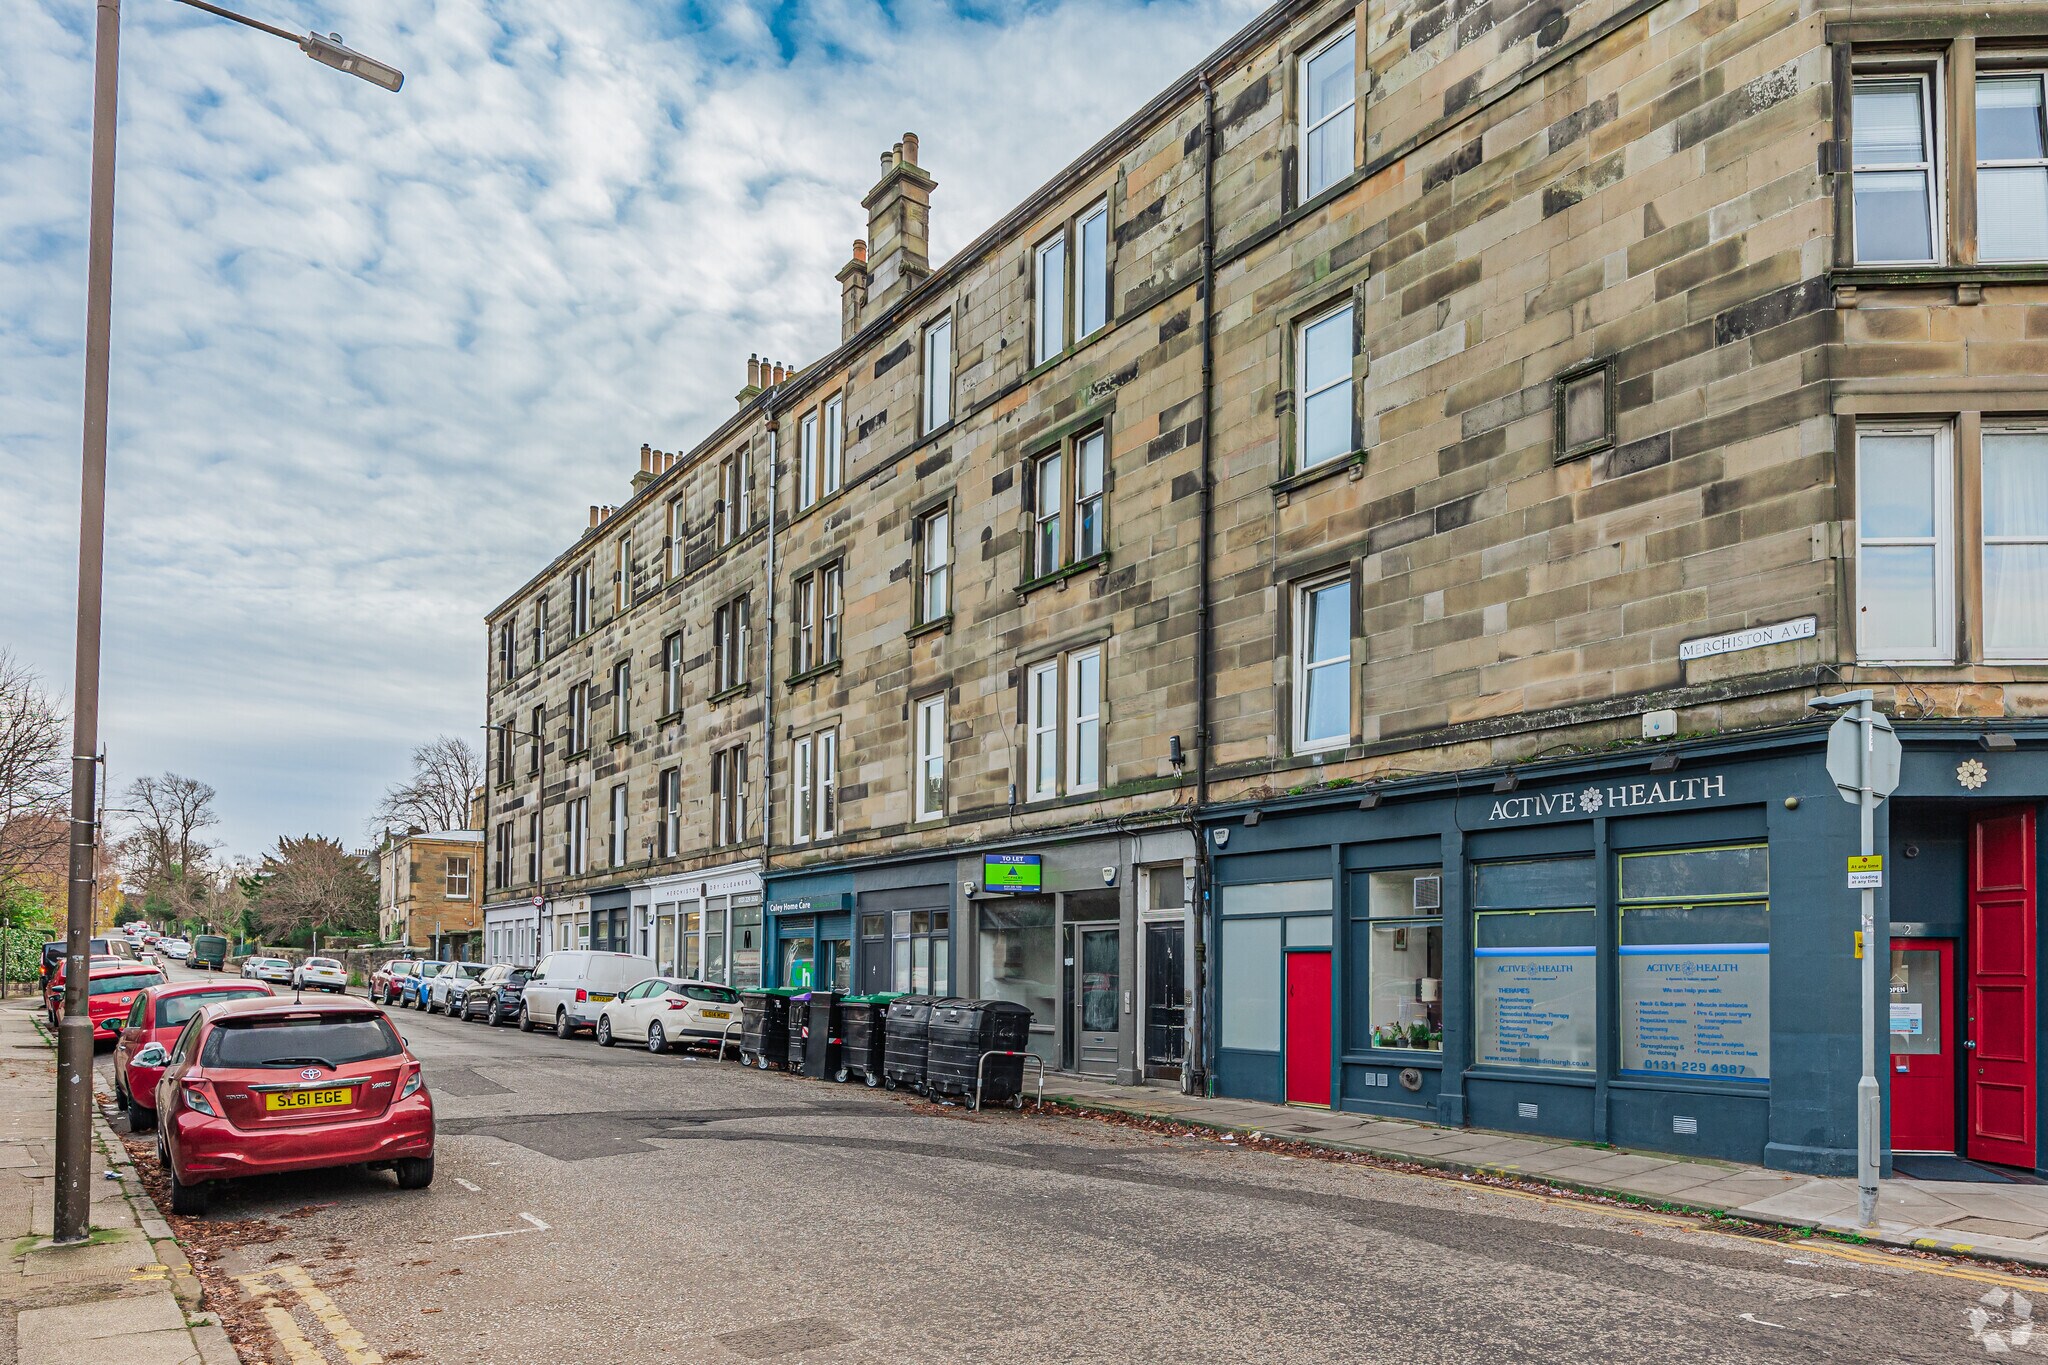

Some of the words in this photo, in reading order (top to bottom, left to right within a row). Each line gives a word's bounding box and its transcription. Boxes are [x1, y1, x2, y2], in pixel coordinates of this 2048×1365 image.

[1683, 629, 1773, 656] MERCHISTON
[1489, 792, 1576, 821] ACTIVE
[1607, 775, 1726, 808] HEALTH
[666, 887, 700, 897] MERCHISTON
[723, 879, 752, 889] CLEANERS
[769, 904, 783, 912] Caley
[783, 903, 799, 911] Home
[799, 901, 811, 909] Care
[1903, 924, 1912, 936] 2
[1497, 964, 1527, 973] ACTIVE
[1538, 964, 1573, 973] HEALTH
[1646, 963, 1681, 972] ACTIVE
[1696, 963, 1738, 972] HEALTH
[1498, 996, 1534, 1004] Physiotherapy
[1640, 1025, 1668, 1033] Pregnancy
[1485, 1055, 1589, 1066] www.activehealthedinburgh.co.uk
[1644, 1060, 1677, 1071] 0131
[1681, 1062, 1707, 1072] 229
[1711, 1064, 1746, 1075] 4987
[277, 1093, 311, 1107] SL61
[314, 1090, 343, 1104] EGE
